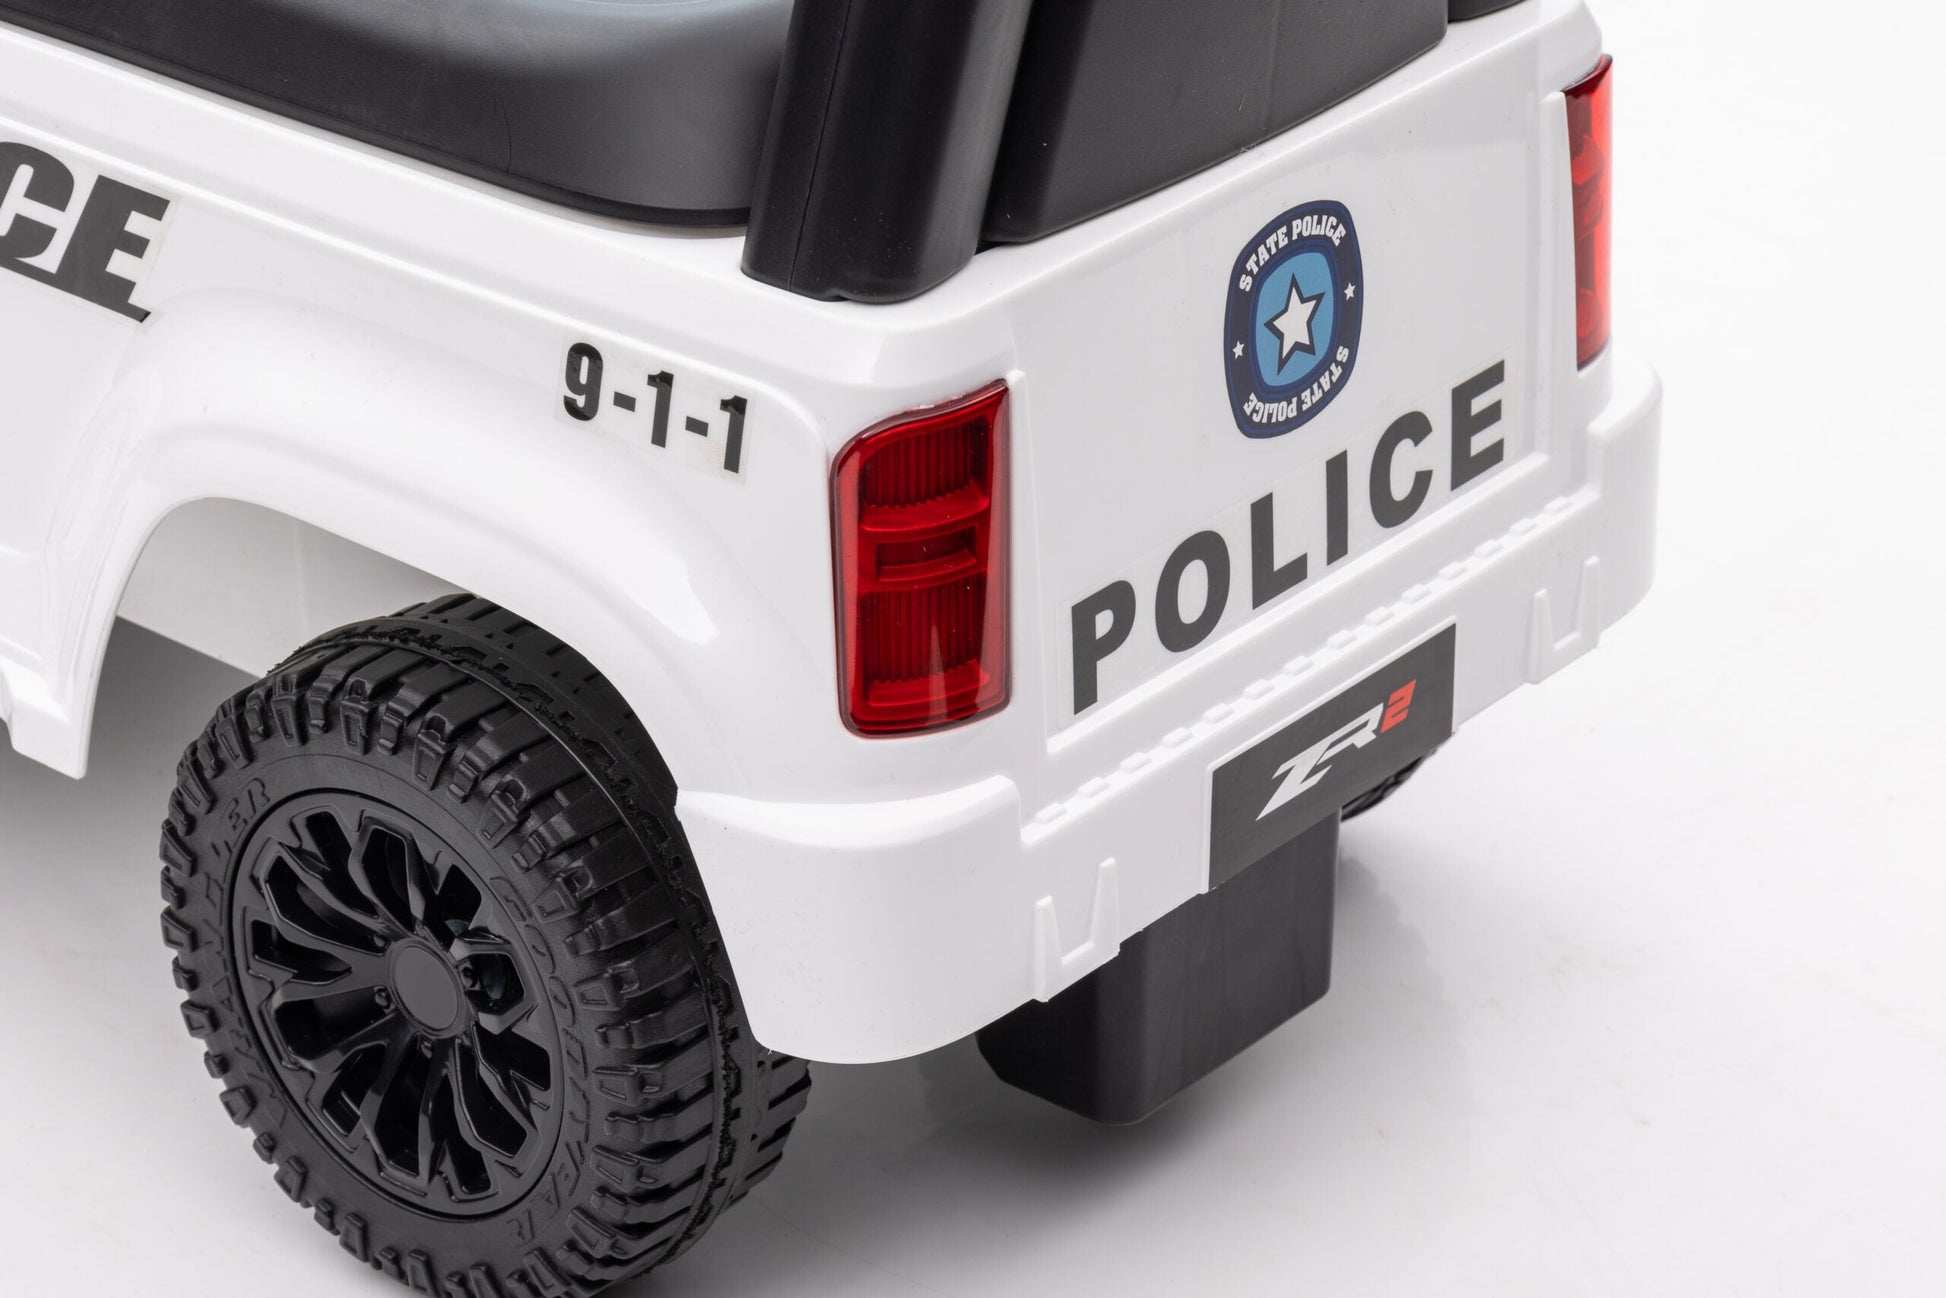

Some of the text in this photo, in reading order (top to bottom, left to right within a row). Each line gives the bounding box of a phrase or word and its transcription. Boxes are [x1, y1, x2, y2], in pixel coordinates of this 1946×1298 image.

[1239, 215, 1346, 292] STATE POLICE
[563, 342, 748, 474] 9-1-1
[1243, 346, 1349, 423] STATE POLICE
[1071, 359, 1505, 715] POLICE
[1256, 679, 1416, 821] ZR2
